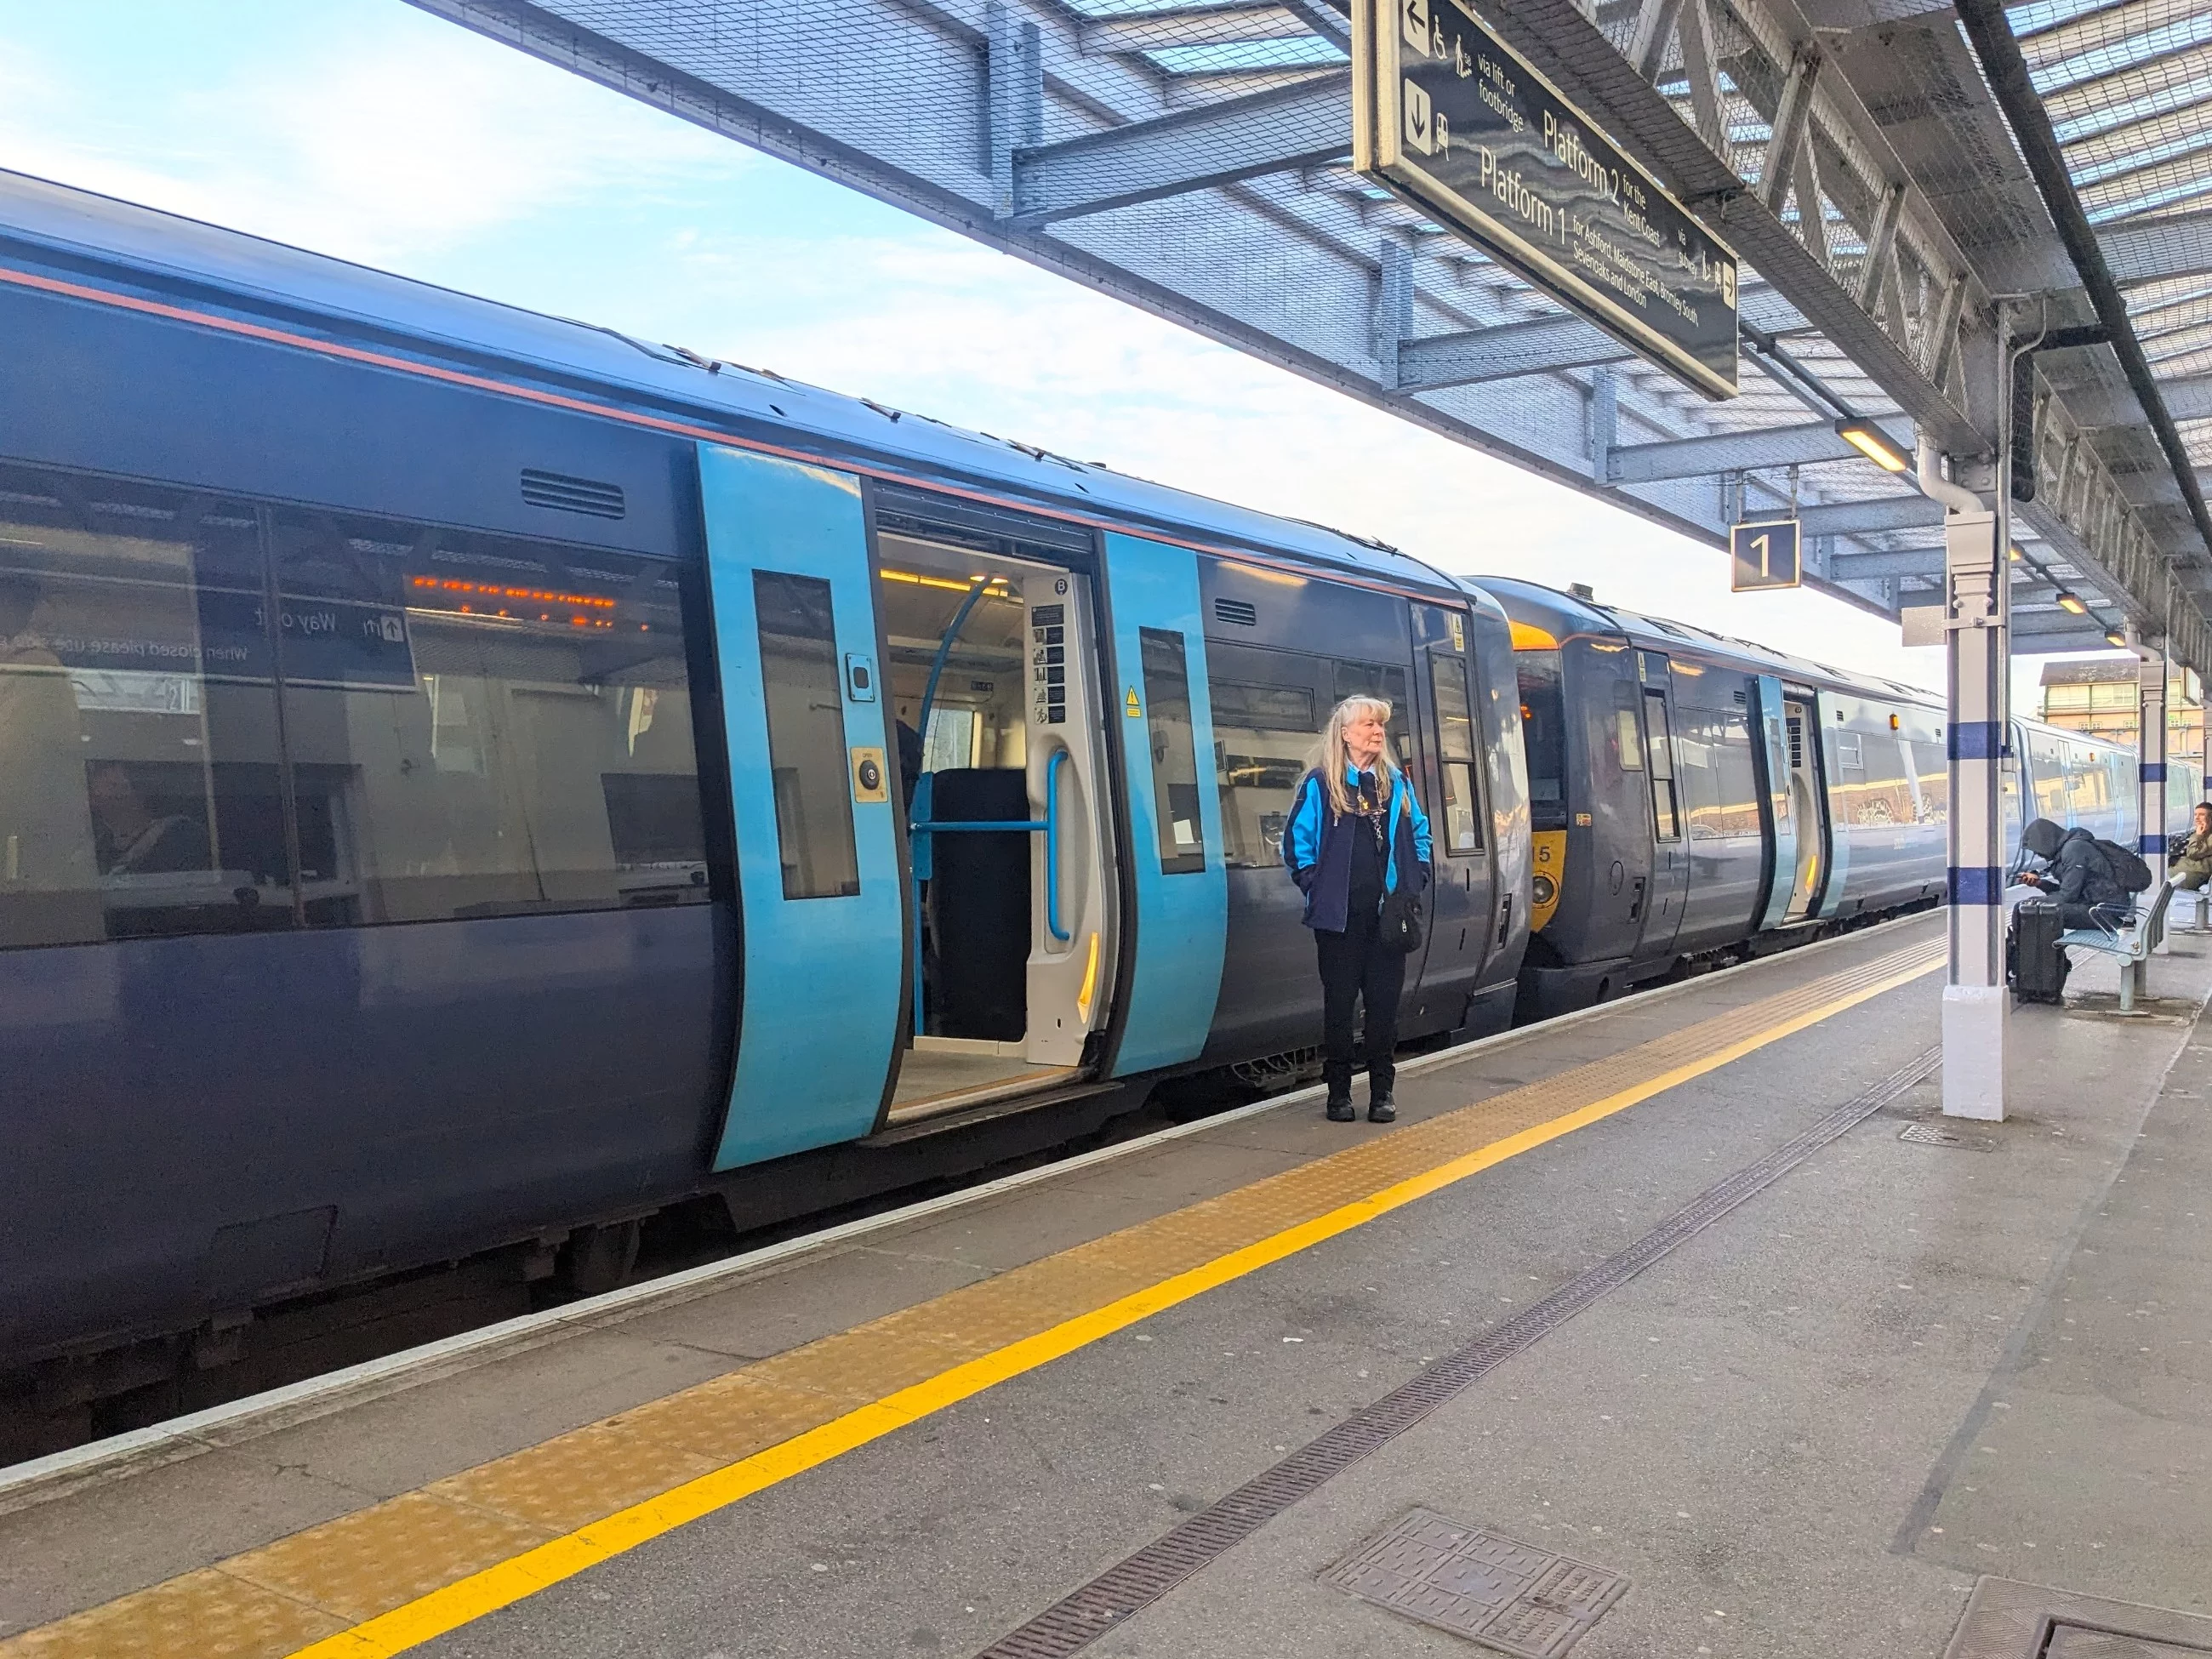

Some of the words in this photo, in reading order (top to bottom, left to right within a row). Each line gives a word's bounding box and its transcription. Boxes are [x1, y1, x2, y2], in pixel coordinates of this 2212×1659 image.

[1478, 54, 1491, 77] via
[1492, 62, 1505, 89] lift
[1506, 79, 1515, 97] or
[1479, 78, 1524, 133] footbridge
[1543, 109, 1608, 196] Platform
[1611, 168, 1620, 207] 2
[1480, 145, 1553, 237] Platform
[1558, 207, 1565, 245] 1
[1622, 174, 1633, 198] for
[1633, 185, 1646, 210] the
[1623, 200, 1641, 231] Kent
[1641, 216, 1661, 248] Coast
[1678, 228, 1686, 246] via
[1572, 214, 1583, 237] for
[1585, 224, 1613, 261] Ashford,
[1613, 245, 1645, 284] Maidstone
[1660, 282, 1683, 316] Bromley
[1573, 240, 1610, 282] Sevenoaks
[1611, 271, 1623, 292] and
[1623, 276, 1647, 309] London
[1679, 252, 1698, 281] subway
[1749, 533, 1770, 578] 1
[1058, 580, 1065, 591] B
